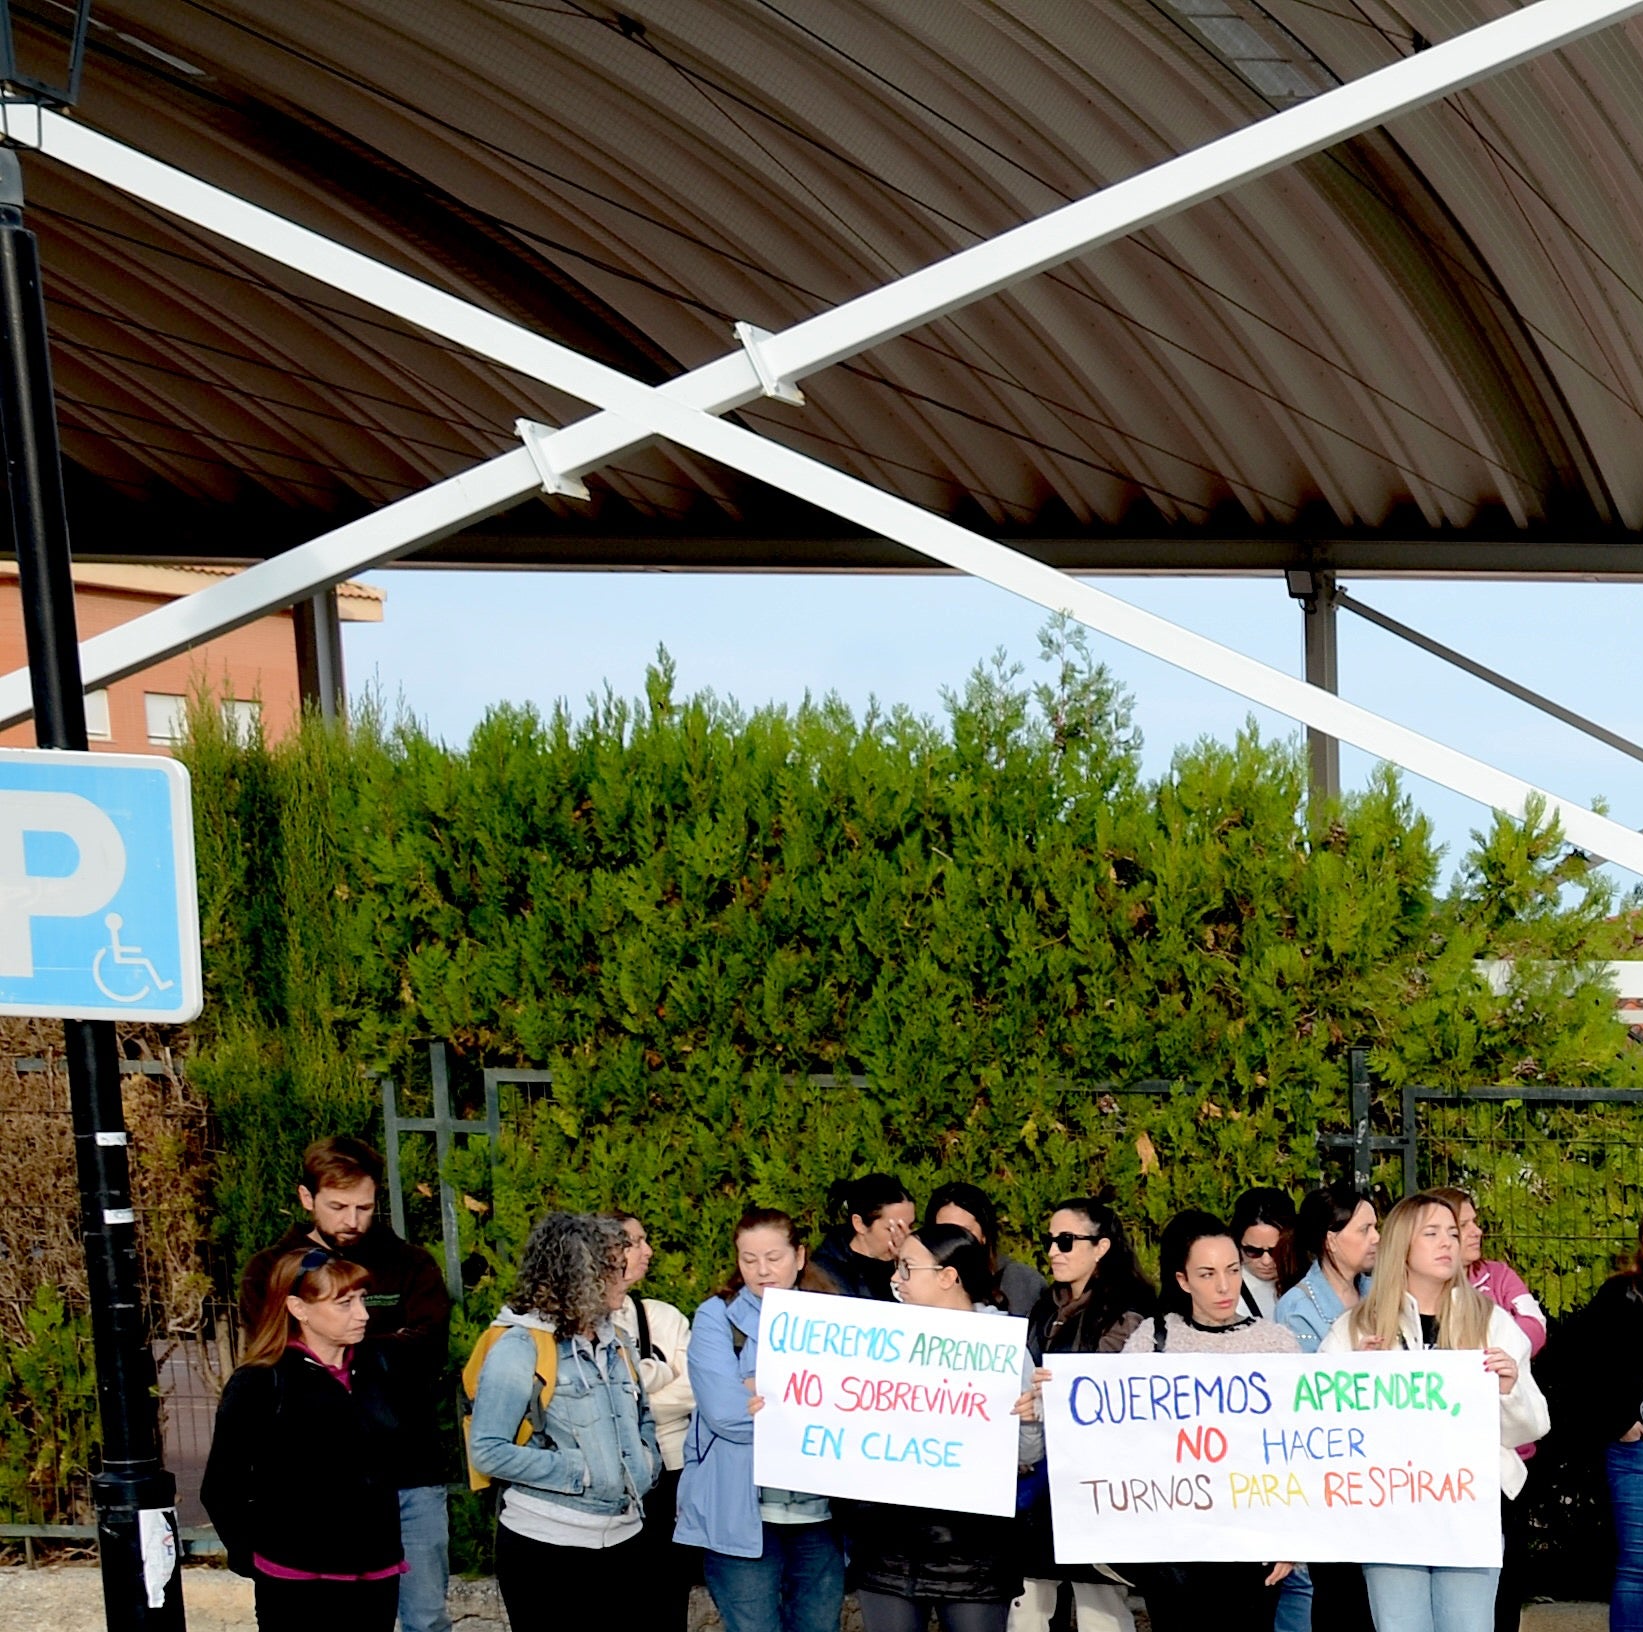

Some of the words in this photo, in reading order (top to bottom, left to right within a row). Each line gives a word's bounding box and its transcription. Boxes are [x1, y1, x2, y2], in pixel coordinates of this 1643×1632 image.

[0, 789, 127, 977] P
[769, 1312, 904, 1363] QUEREMOS
[909, 1333, 1019, 1375] APRENDER
[783, 1371, 823, 1406] NO
[1068, 1371, 1272, 1427] QUEREMOS
[1293, 1370, 1461, 1417] APRENDER,
[801, 1424, 845, 1460] EN
[861, 1432, 963, 1468] CLASE
[1176, 1425, 1228, 1463] NO
[1263, 1427, 1366, 1464] HACER
[1081, 1474, 1213, 1515] TURNOS
[1229, 1472, 1308, 1509] PARA
[1324, 1461, 1475, 1509] RESPIRAR
